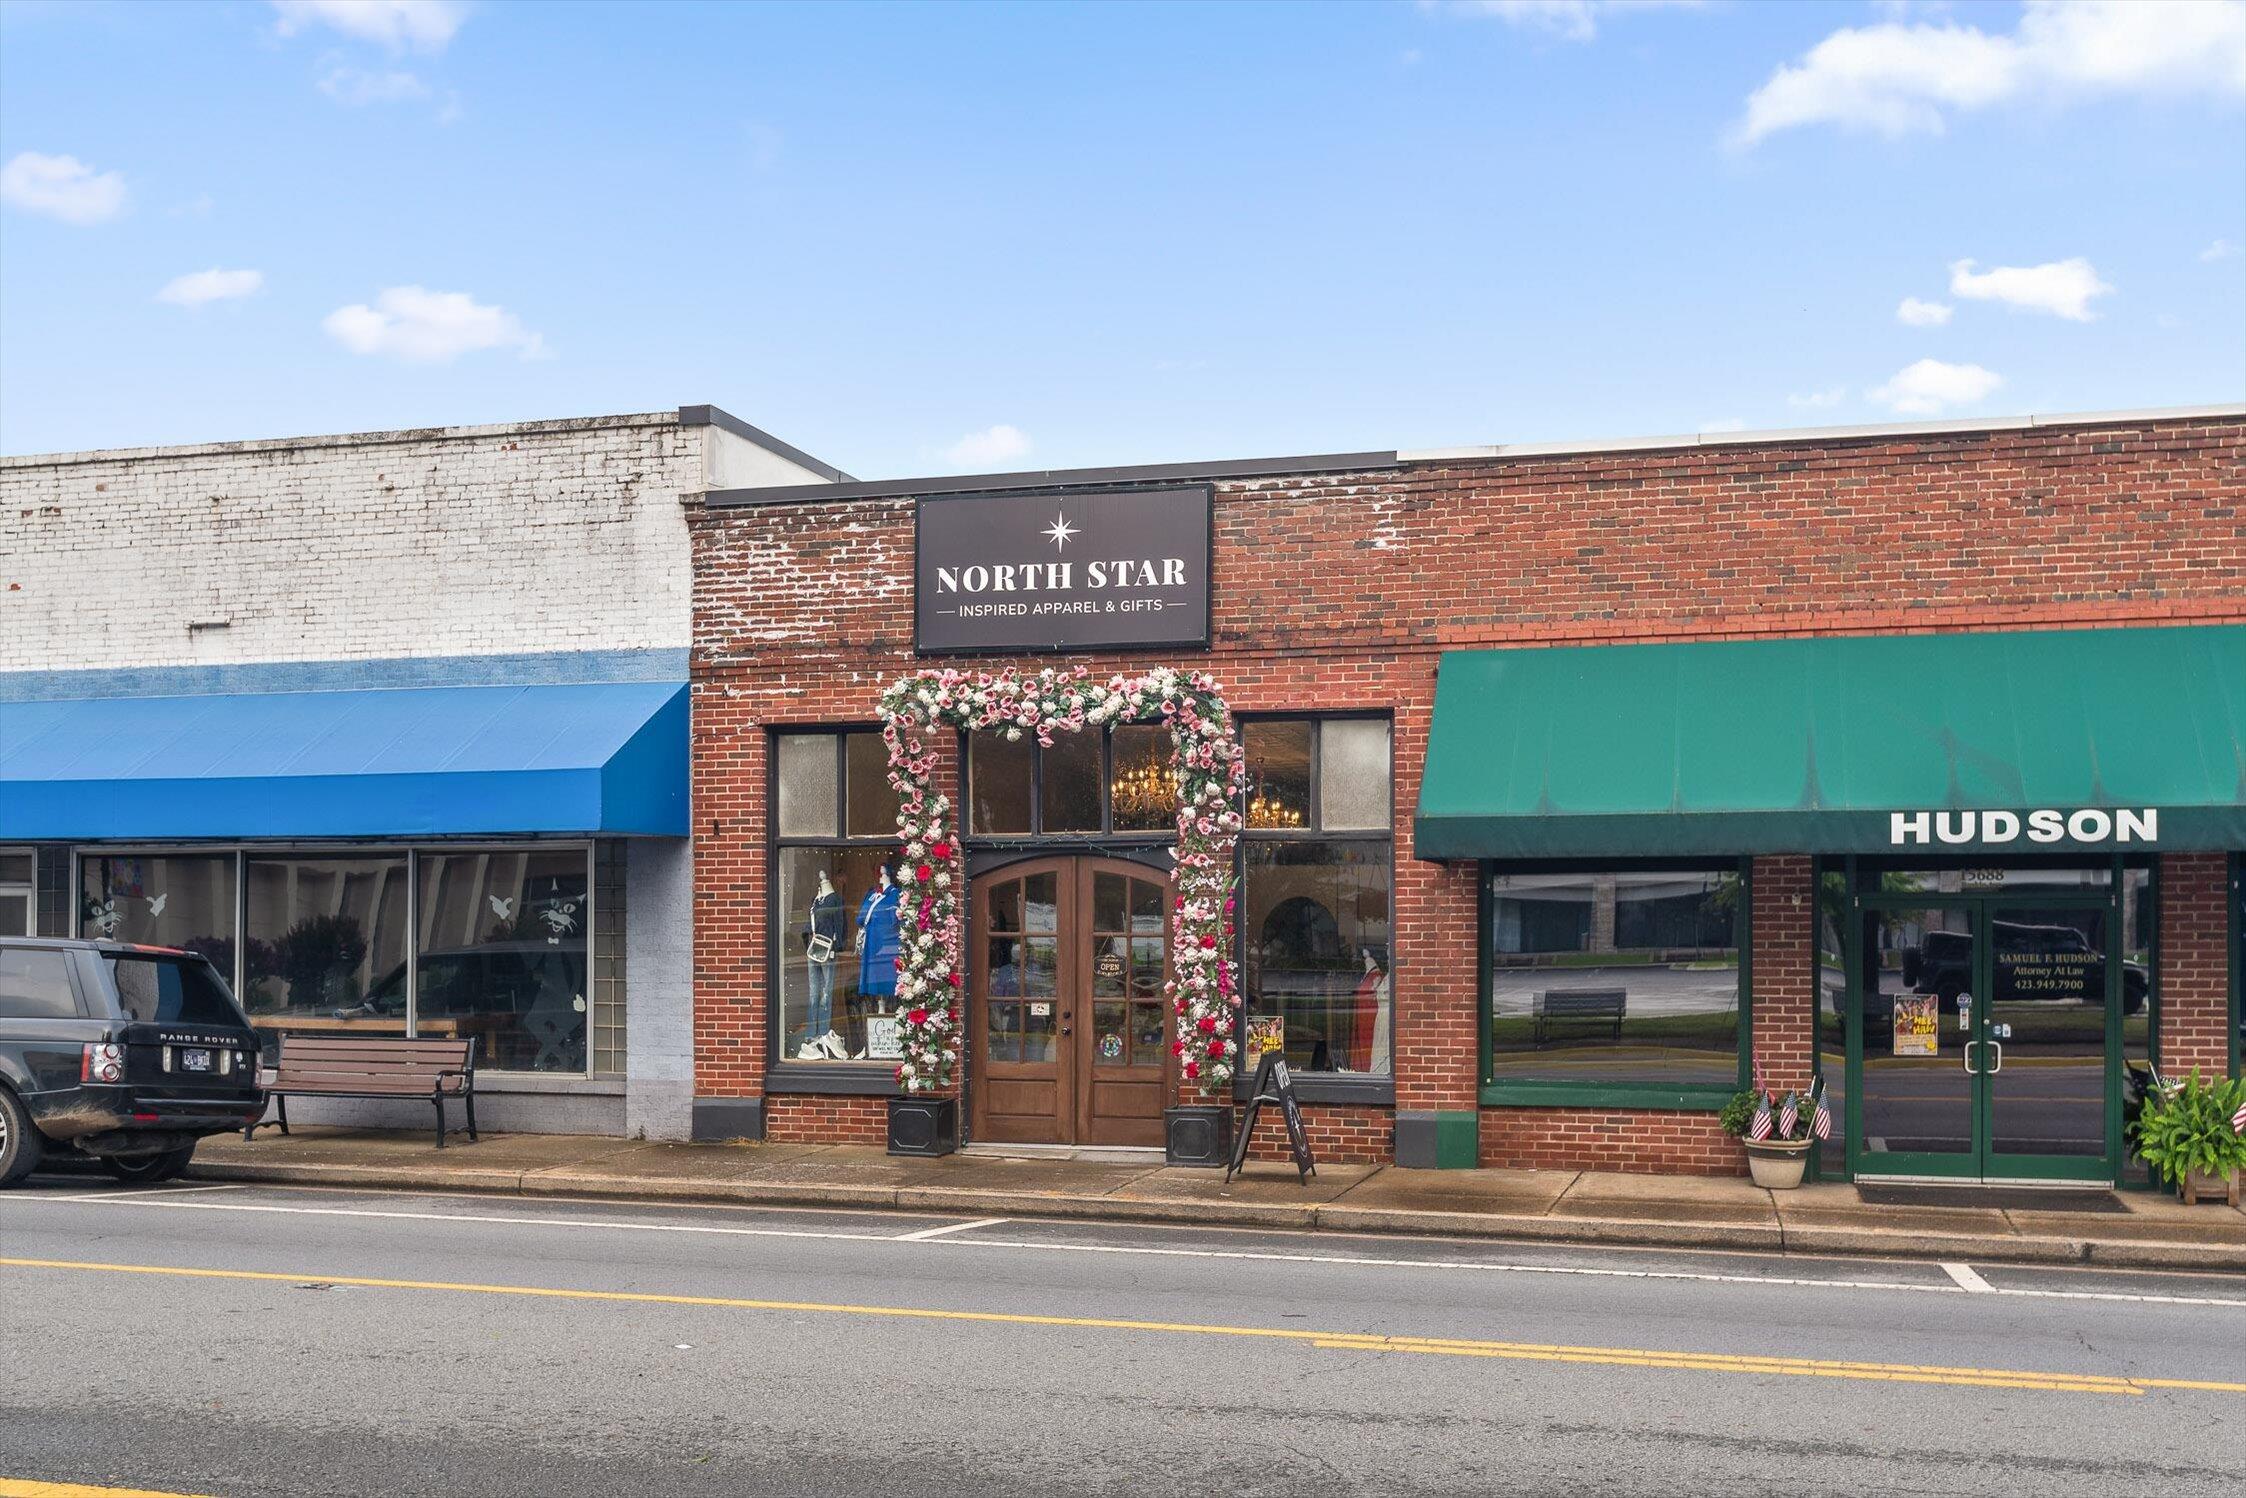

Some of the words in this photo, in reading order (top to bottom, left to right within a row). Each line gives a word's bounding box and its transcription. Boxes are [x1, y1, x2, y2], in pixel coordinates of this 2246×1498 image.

[936, 562, 1073, 594] NORTH
[1087, 558, 1187, 589] STAR
[959, 603, 1028, 617] INSPIRED
[1032, 601, 1100, 616] APPAREL
[1105, 601, 1116, 613] &
[1120, 599, 1163, 613] GIFTS
[1890, 808, 2158, 845] HUDSON
[1961, 868, 2004, 881] 15688
[2000, 953, 2041, 963] SAMUEL
[2055, 953, 2098, 963] HUDSON
[1100, 963, 1120, 971] OPEN
[2013, 966, 2052, 978] Attorney
[2054, 966, 2065, 975] At
[2067, 966, 2084, 975] Law
[2015, 979, 2084, 990] 423.949.7900
[160, 1033, 199, 1042] RANGE
[204, 1036, 238, 1044] ROVER
